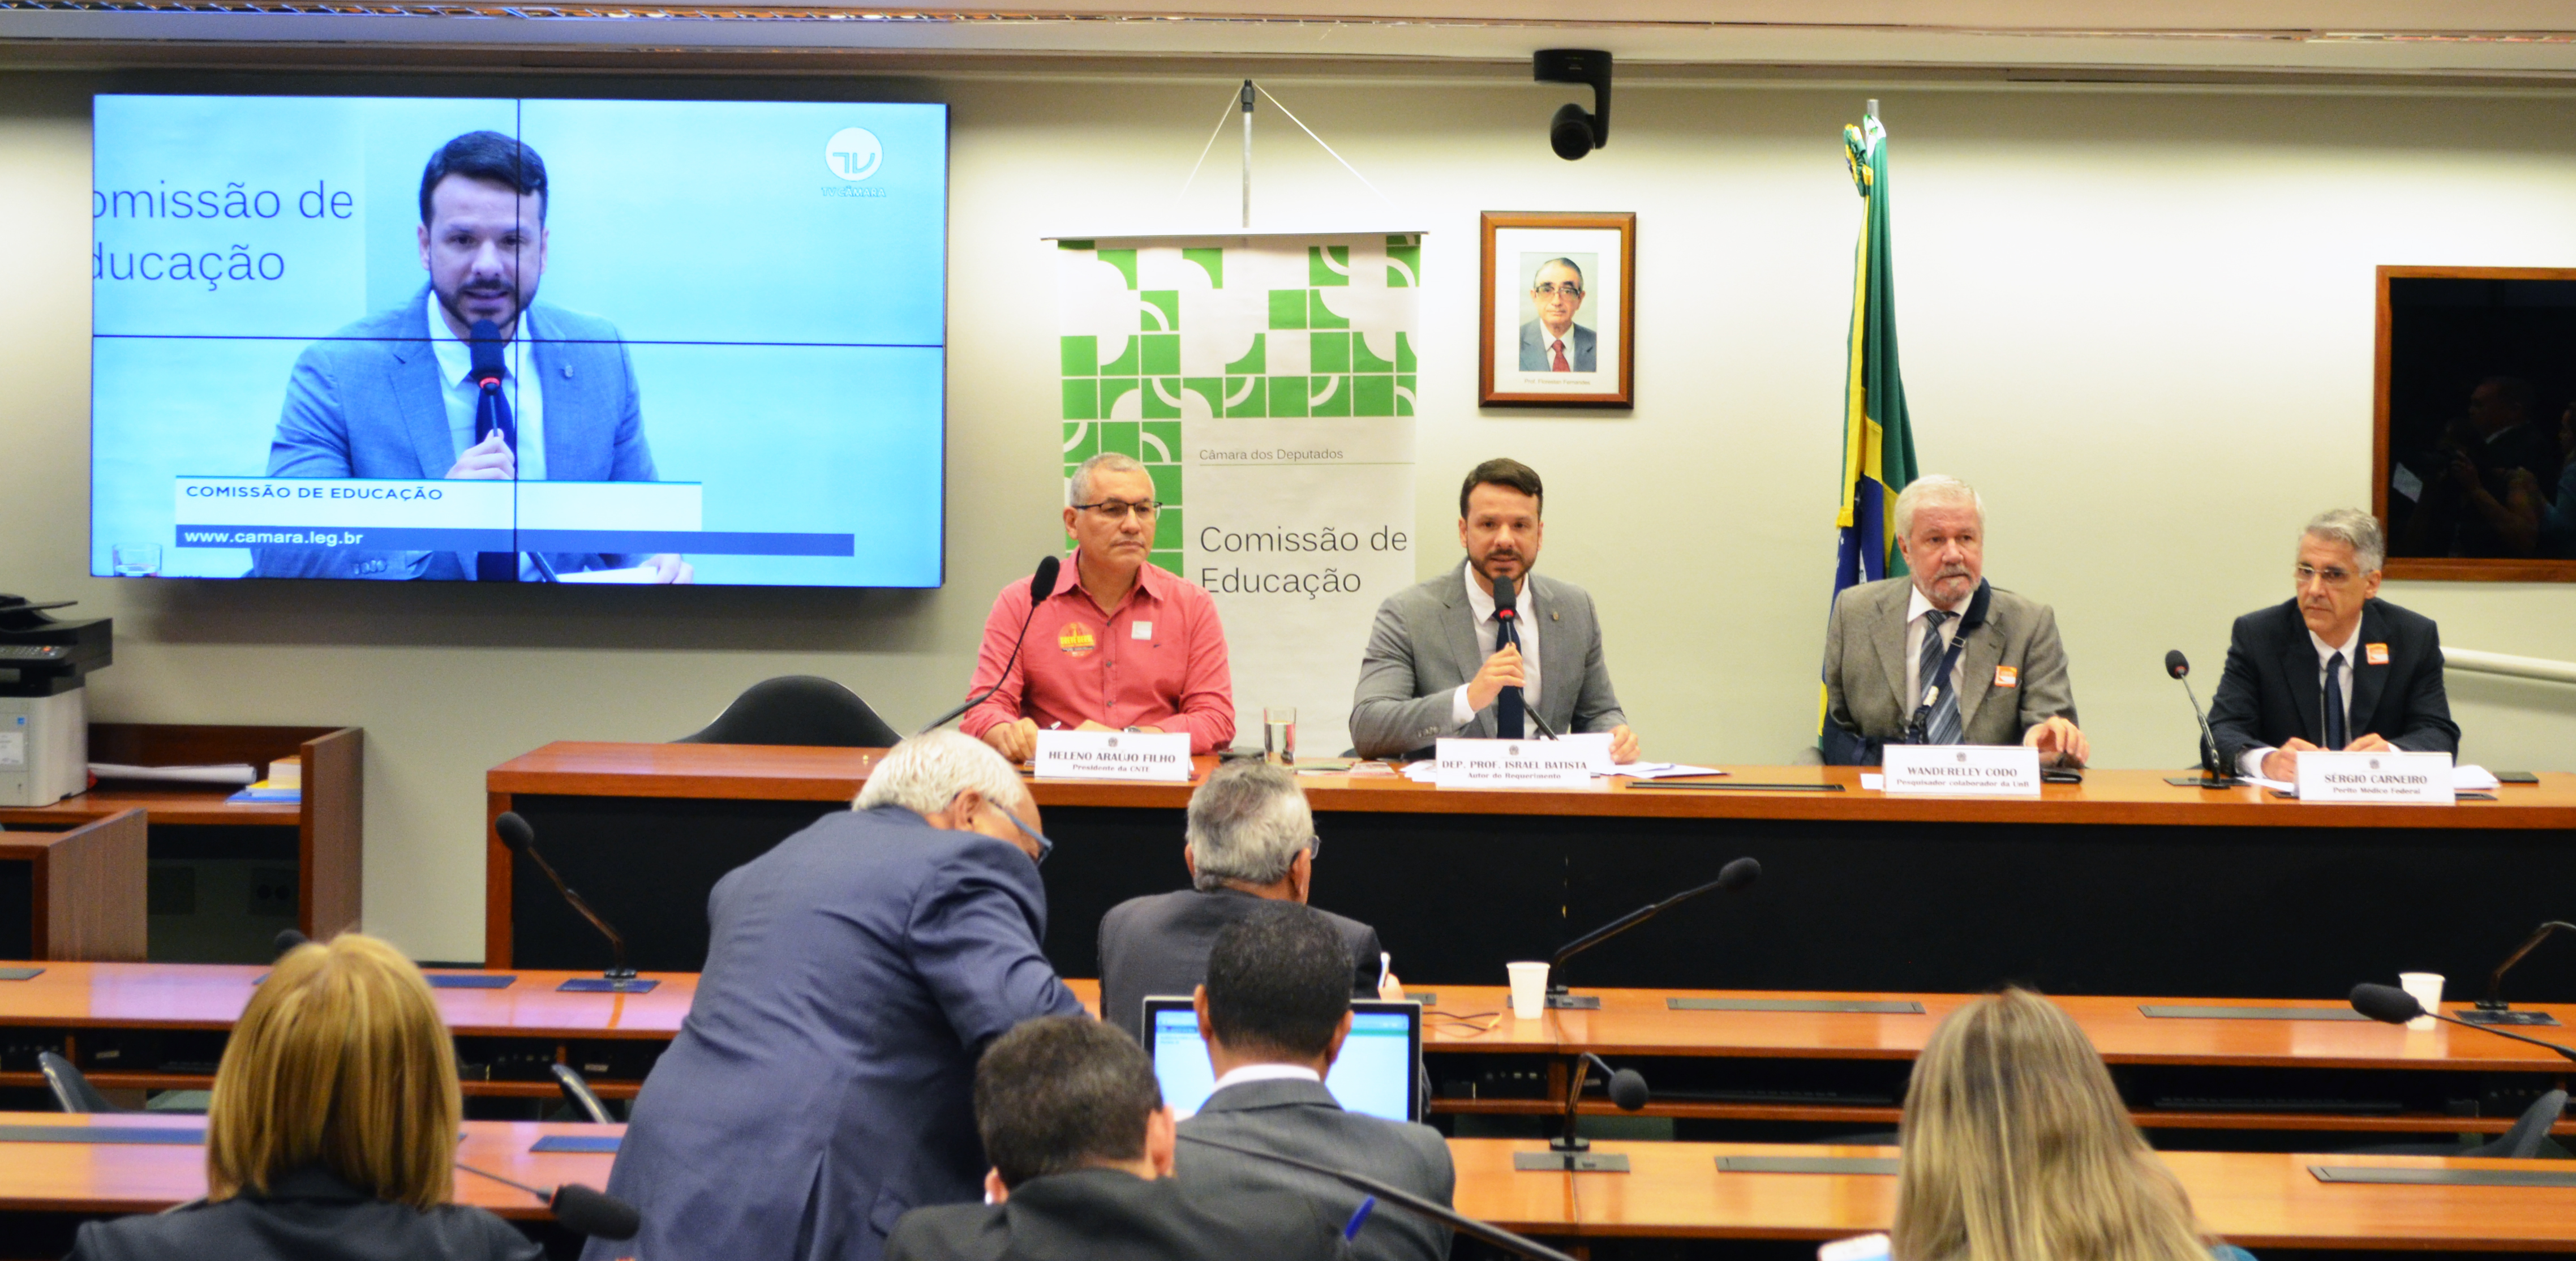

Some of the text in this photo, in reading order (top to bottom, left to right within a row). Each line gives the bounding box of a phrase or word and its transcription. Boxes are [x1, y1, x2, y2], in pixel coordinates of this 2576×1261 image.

[821, 187, 836, 196] TV
[299, 180, 353, 219] de
[1199, 449, 1343, 462] Câmara dos Deputados
[186, 484, 443, 501] COMISSÃO DE EDUCAÇÃO
[184, 531, 363, 547] www.camara.leg.br
[1200, 525, 1407, 552] Comissão de
[1202, 567, 1361, 600] Educação
[1049, 750, 1176, 763] HELENO ARAÚJO FILHO
[1442, 760, 1466, 769] DEP.
[1505, 761, 1540, 769] ISRAEL
[1545, 761, 1587, 770] BATISTA
[1907, 767, 2017, 777] WANDERELEY CODO
[2324, 773, 2427, 784] SÉRGIO CARNEIRO
